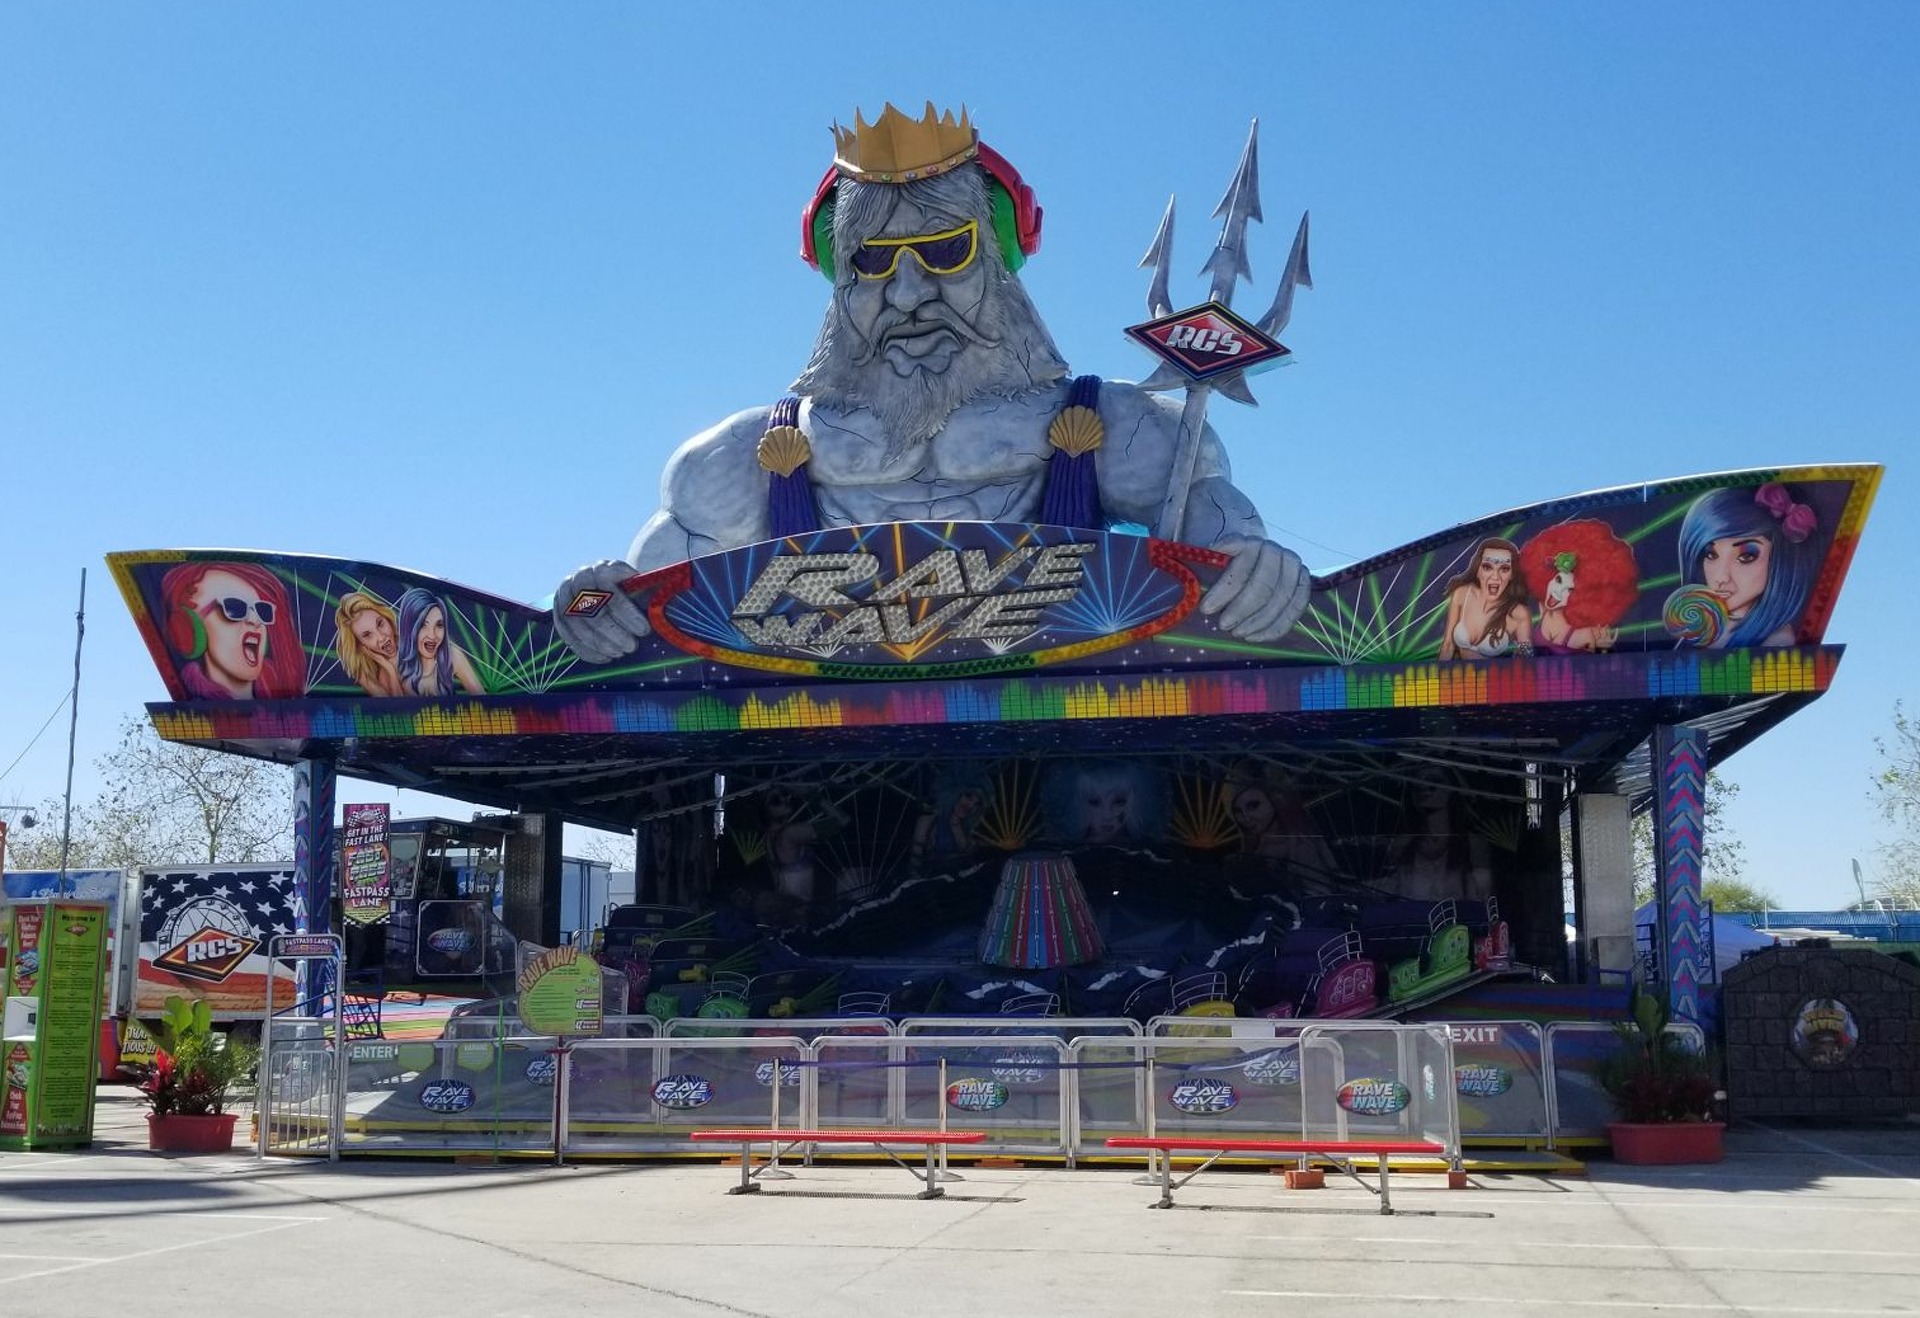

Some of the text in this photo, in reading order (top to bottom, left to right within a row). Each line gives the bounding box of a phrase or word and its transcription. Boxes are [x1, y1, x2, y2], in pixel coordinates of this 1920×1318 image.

[1164, 324, 1243, 355] RCS
[731, 543, 1096, 616] RAVE
[731, 587, 1082, 647] WAVE
[370, 825, 383, 834] THE
[345, 836, 362, 847] FAST
[344, 886, 390, 899] FASTPASS
[352, 898, 382, 908] LANE
[187, 937, 242, 962] RCS
[518, 946, 578, 993] RAVE WAVE
[1451, 1027, 1498, 1042] EXIT
[354, 1046, 392, 1059] ENTER
[1243, 1068, 1298, 1078] WAVE
[1461, 1069, 1498, 1081] RAVE
[422, 1086, 471, 1097] RAVE
[655, 1081, 709, 1093] RAVE
[959, 1082, 994, 1094] RAVE
[1172, 1086, 1232, 1098] RAVE
[1353, 1083, 1394, 1096] RAVE
[1460, 1080, 1500, 1093] WAVE
[422, 1096, 470, 1105] WAVE
[655, 1090, 707, 1100] WAVE
[958, 1093, 997, 1106] WAVE
[1172, 1095, 1230, 1105] WAVE
[1353, 1095, 1397, 1108] WAVE
